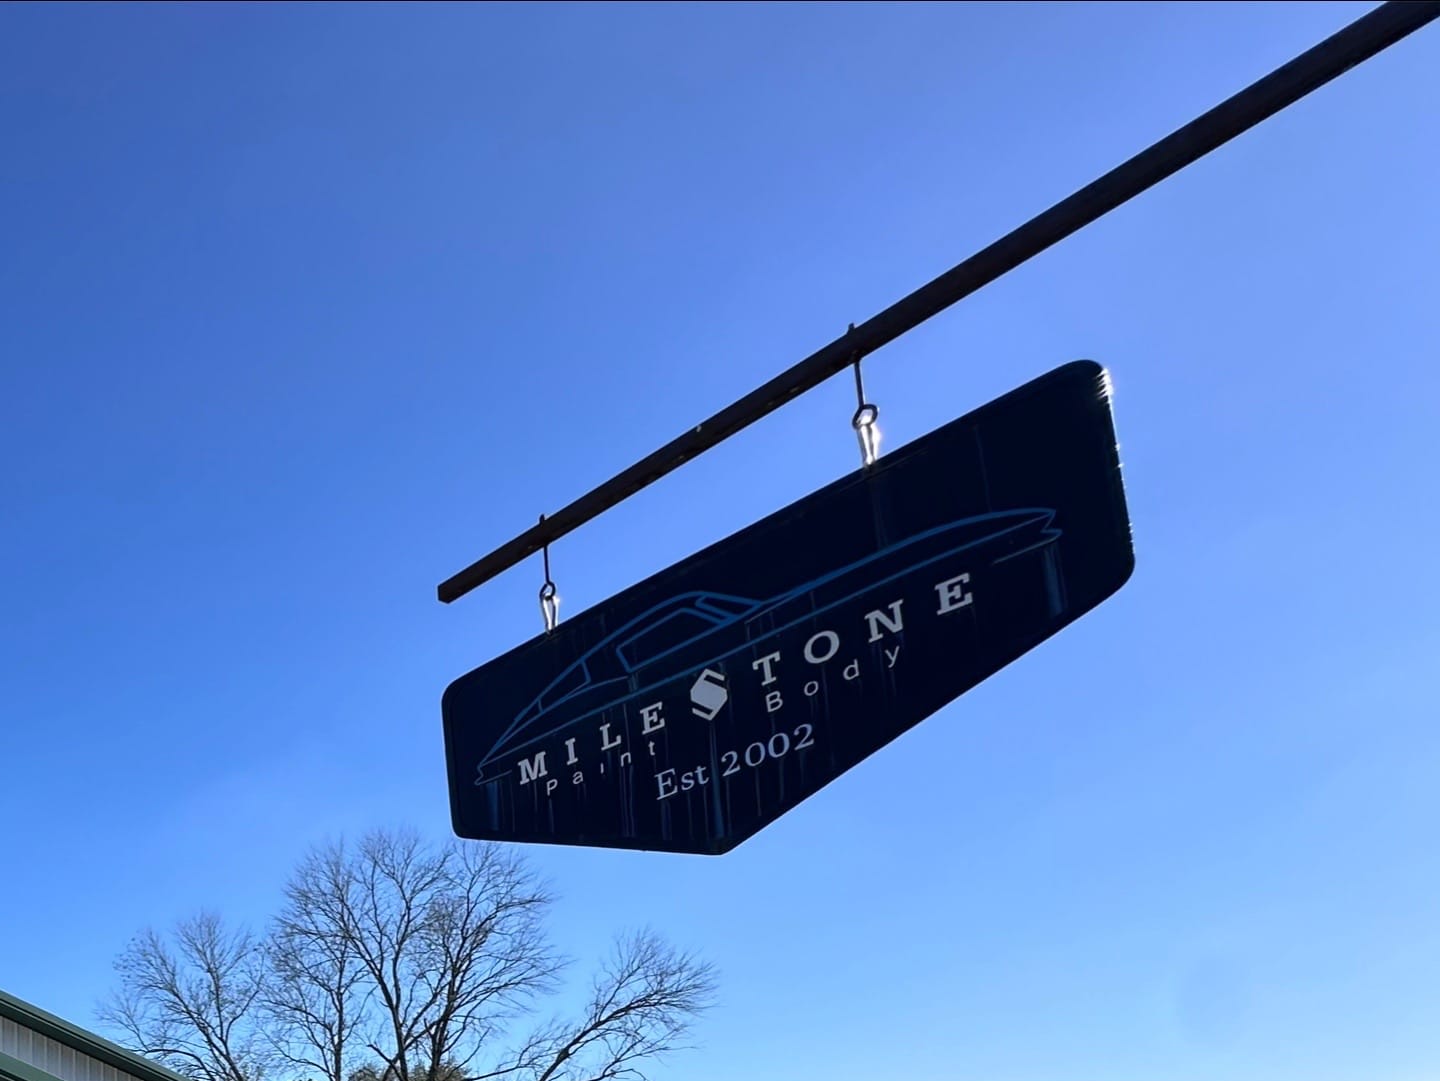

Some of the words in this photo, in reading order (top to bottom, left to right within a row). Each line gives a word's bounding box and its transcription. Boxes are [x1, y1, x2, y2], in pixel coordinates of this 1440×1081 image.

[517, 572, 974, 785] MILESTONE
[545, 740, 656, 796] Paint
[765, 645, 900, 713] Body
[653, 764, 710, 801] Est
[720, 723, 815, 777] 2002
